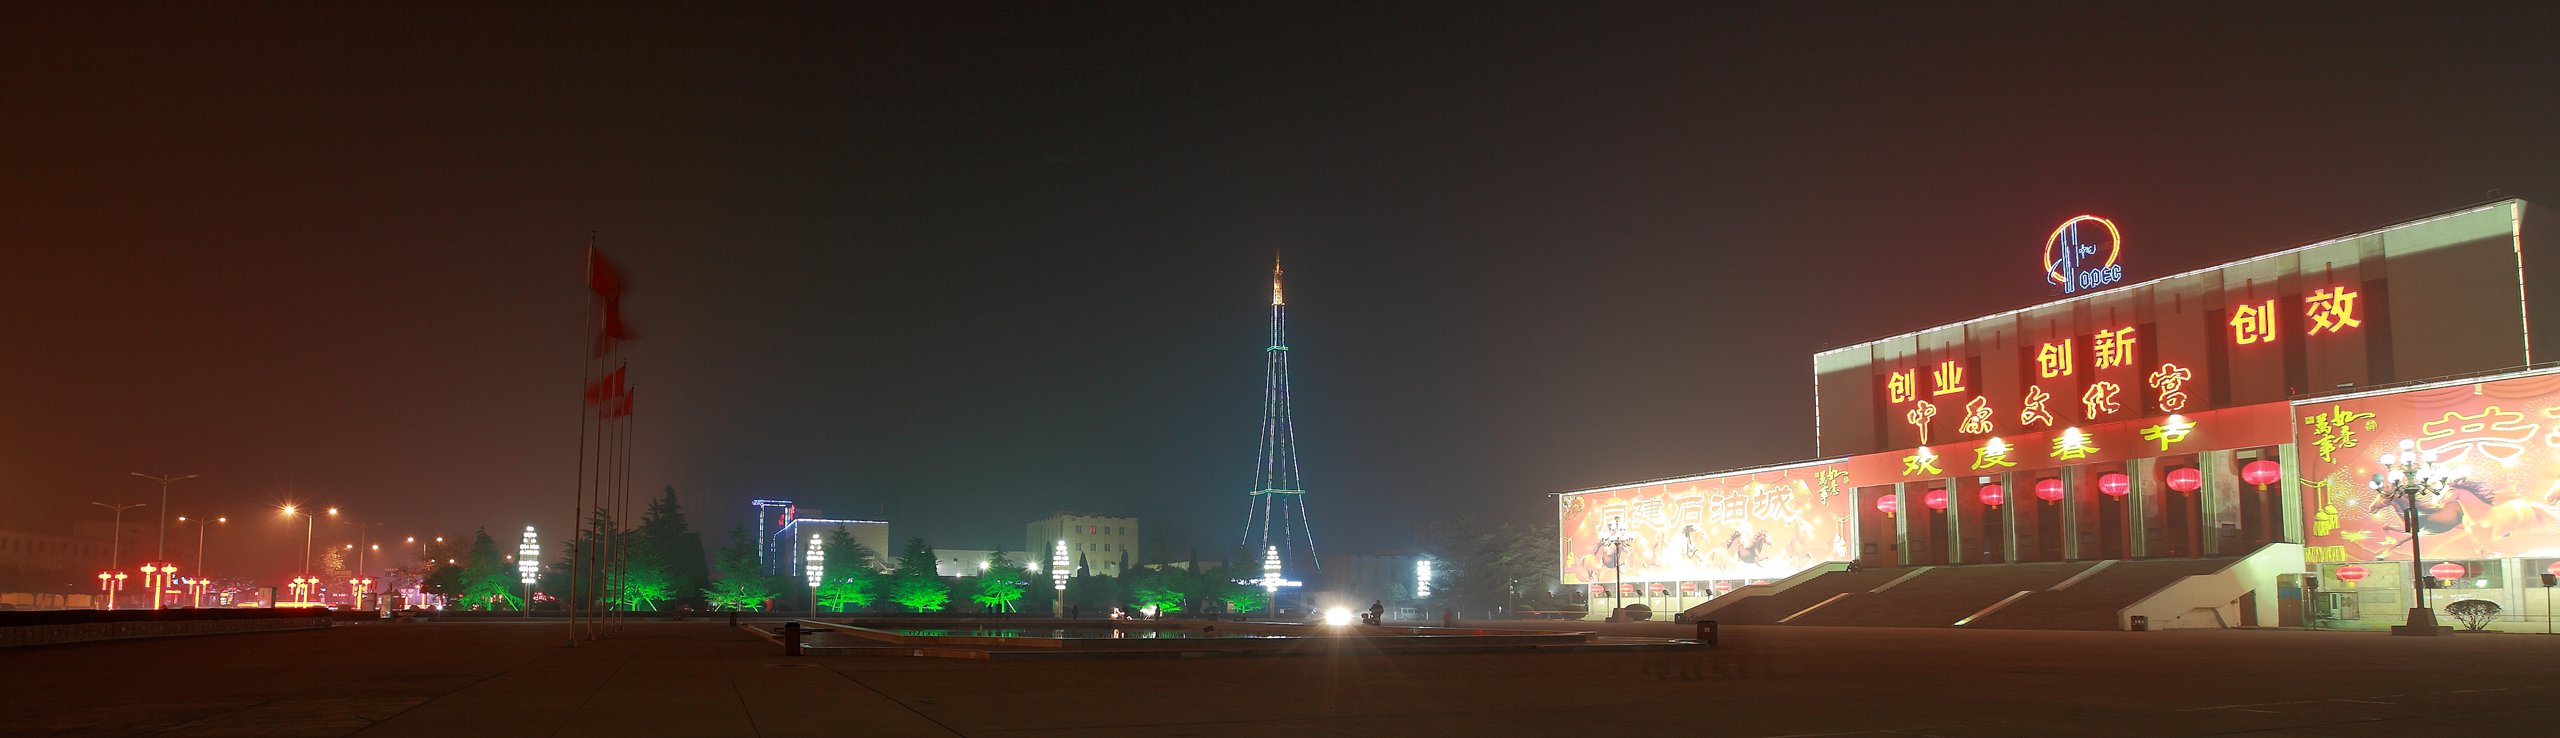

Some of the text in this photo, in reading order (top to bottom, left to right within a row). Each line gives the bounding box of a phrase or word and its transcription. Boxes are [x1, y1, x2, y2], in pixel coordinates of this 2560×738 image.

[2079, 264, 2122, 290] OPEC
[1887, 286, 2362, 404] 创业 创新 创效
[1906, 363, 2192, 446] 中原文化宫
[2416, 404, 2560, 465] 共
[1902, 416, 2198, 477] 欢度春节
